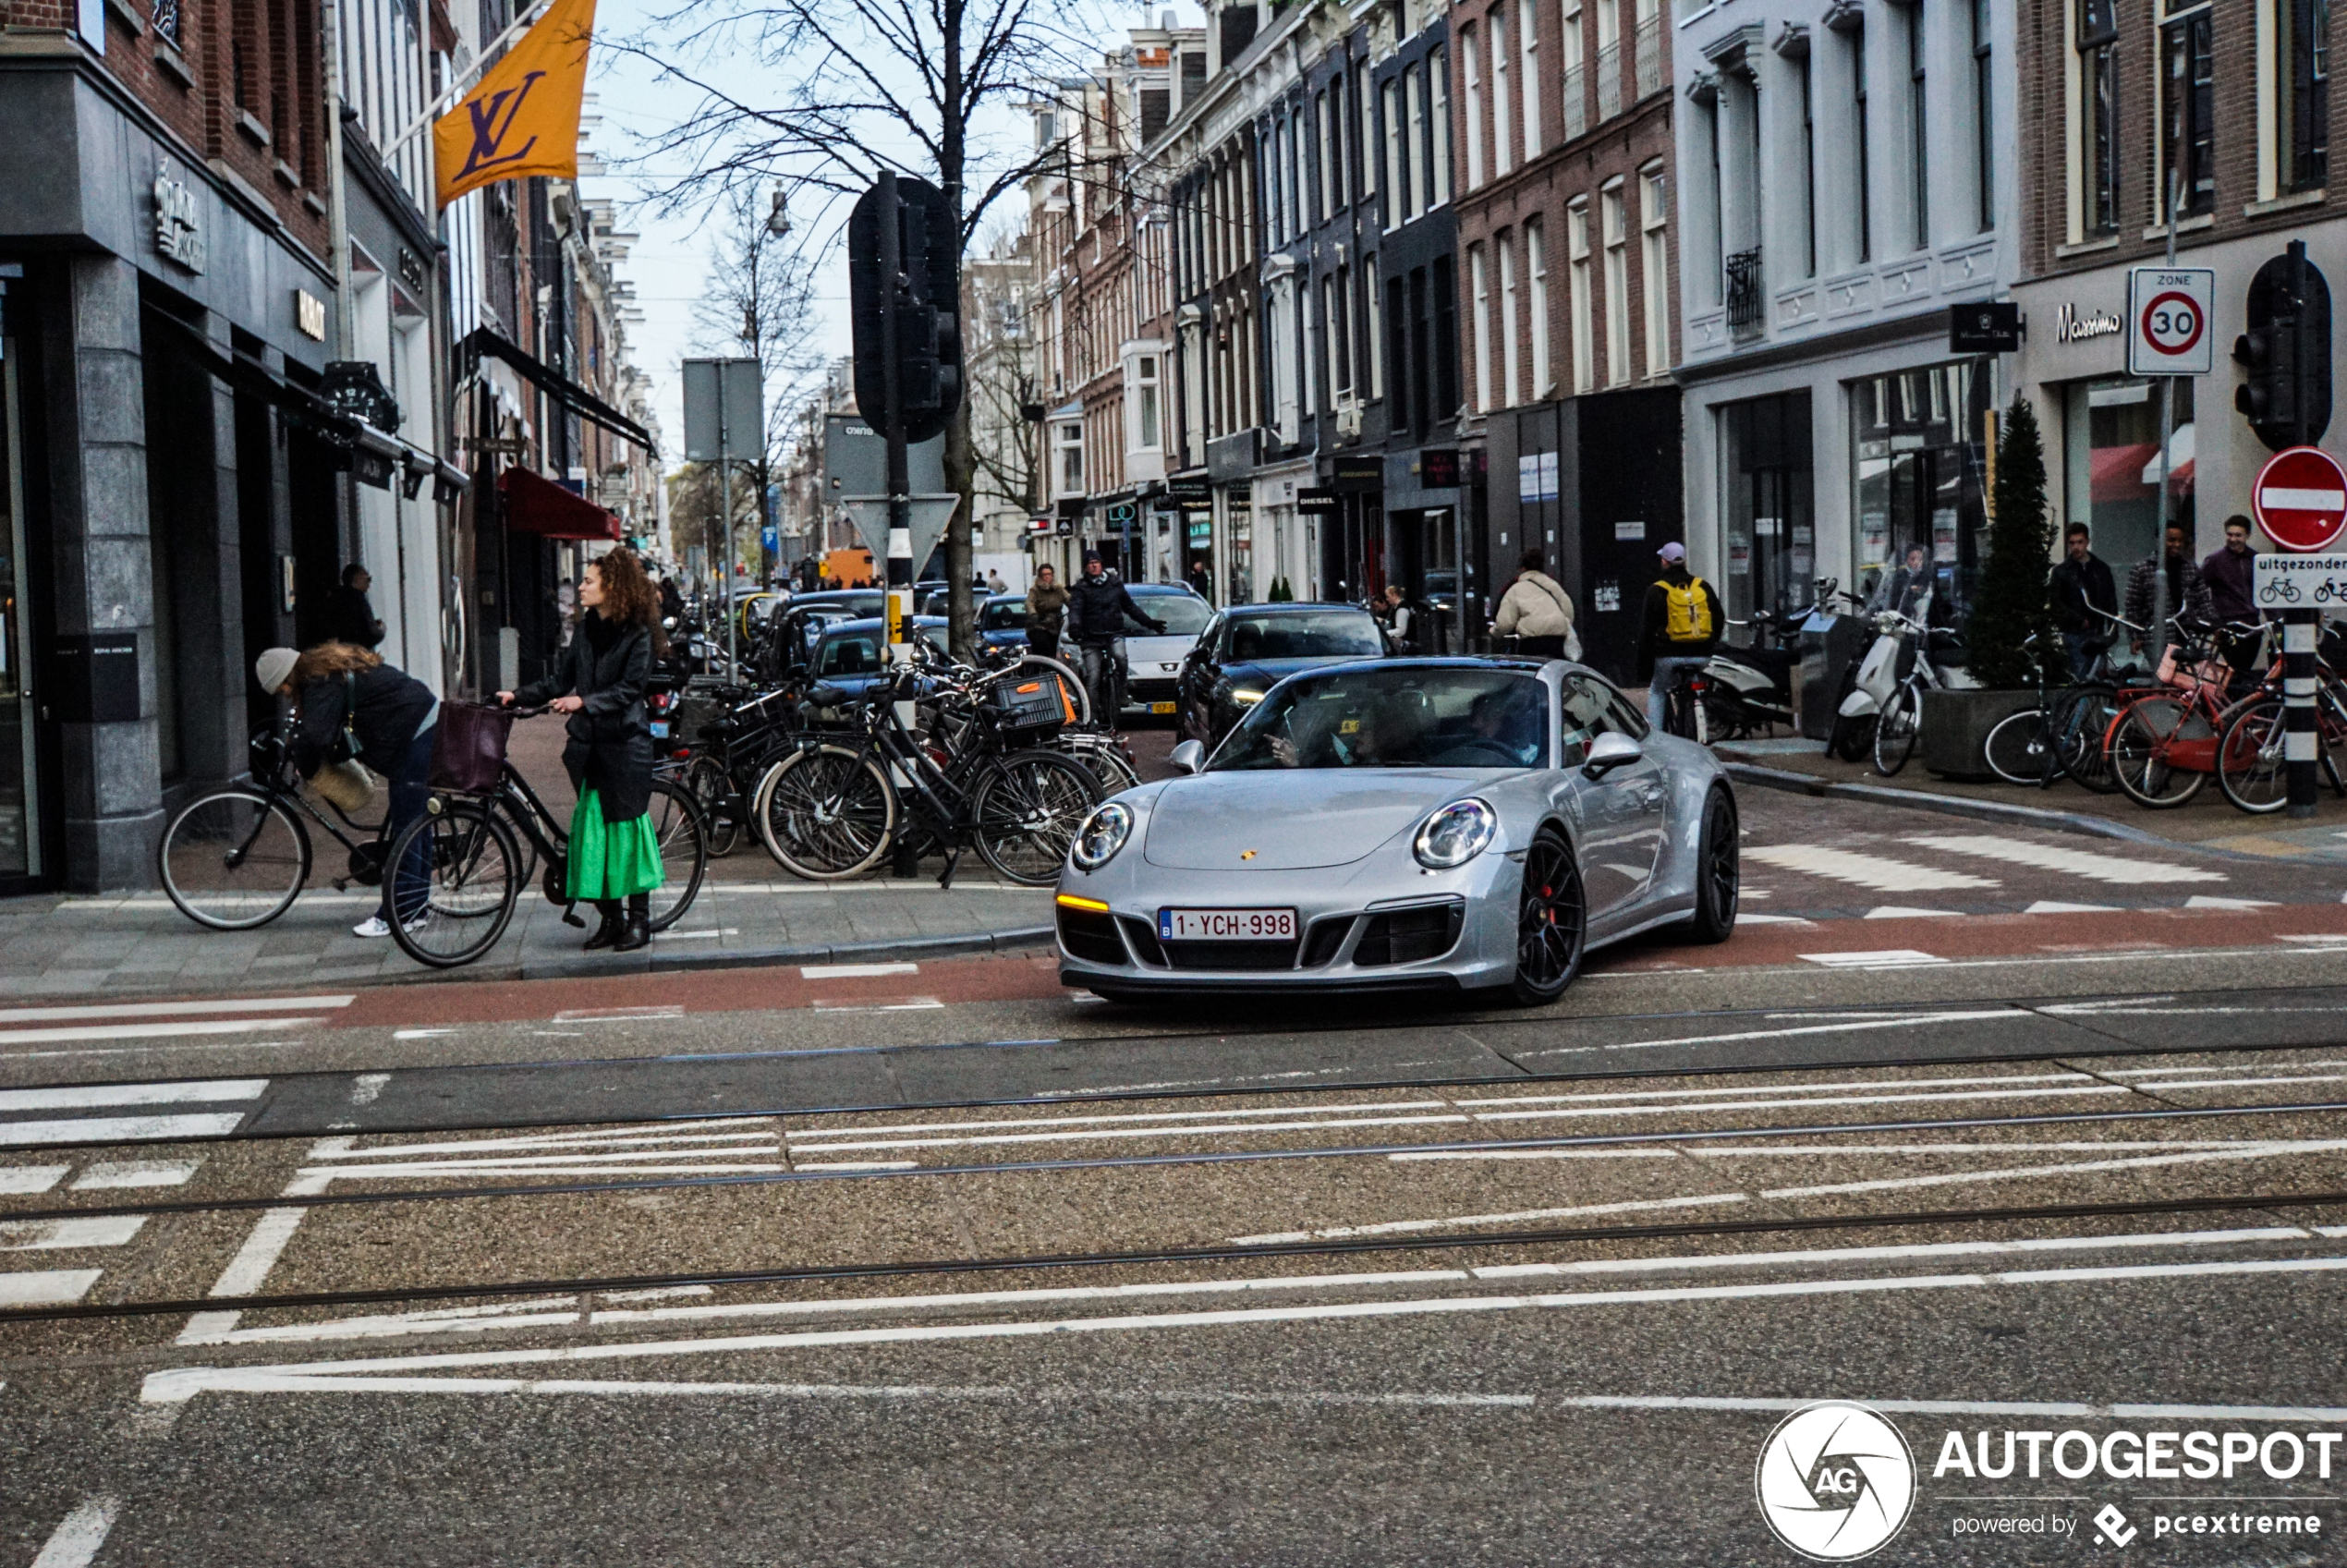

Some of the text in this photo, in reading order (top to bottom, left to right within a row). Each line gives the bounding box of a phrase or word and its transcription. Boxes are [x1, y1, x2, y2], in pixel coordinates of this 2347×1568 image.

[2158, 275, 2192, 286] ZONE
[2056, 302, 2122, 343] Massimo
[2153, 311, 2194, 334] 30
[1299, 497, 1335, 505] DIESEL
[1162, 914, 1291, 936] B 1-YCH-998
